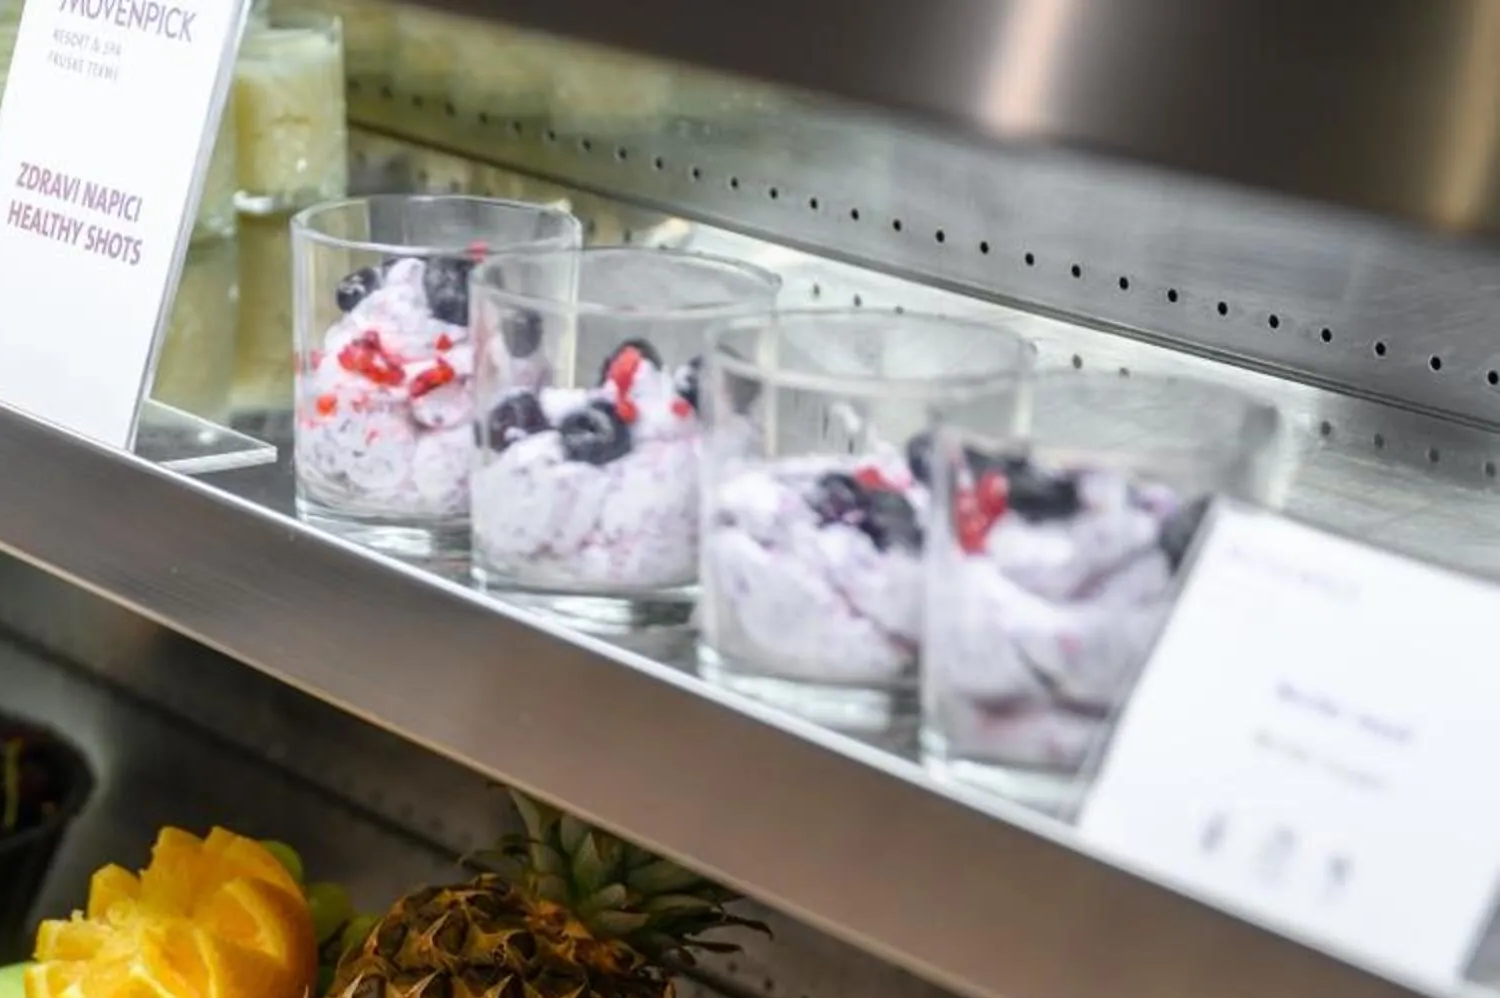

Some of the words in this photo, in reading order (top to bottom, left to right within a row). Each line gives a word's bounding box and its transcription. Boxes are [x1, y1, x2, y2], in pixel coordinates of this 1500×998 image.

[15, 161, 81, 205] ZDRAVI
[81, 181, 143, 223] NAPICI
[6, 198, 84, 246] HEALTHY
[84, 224, 143, 266] SHOTS
